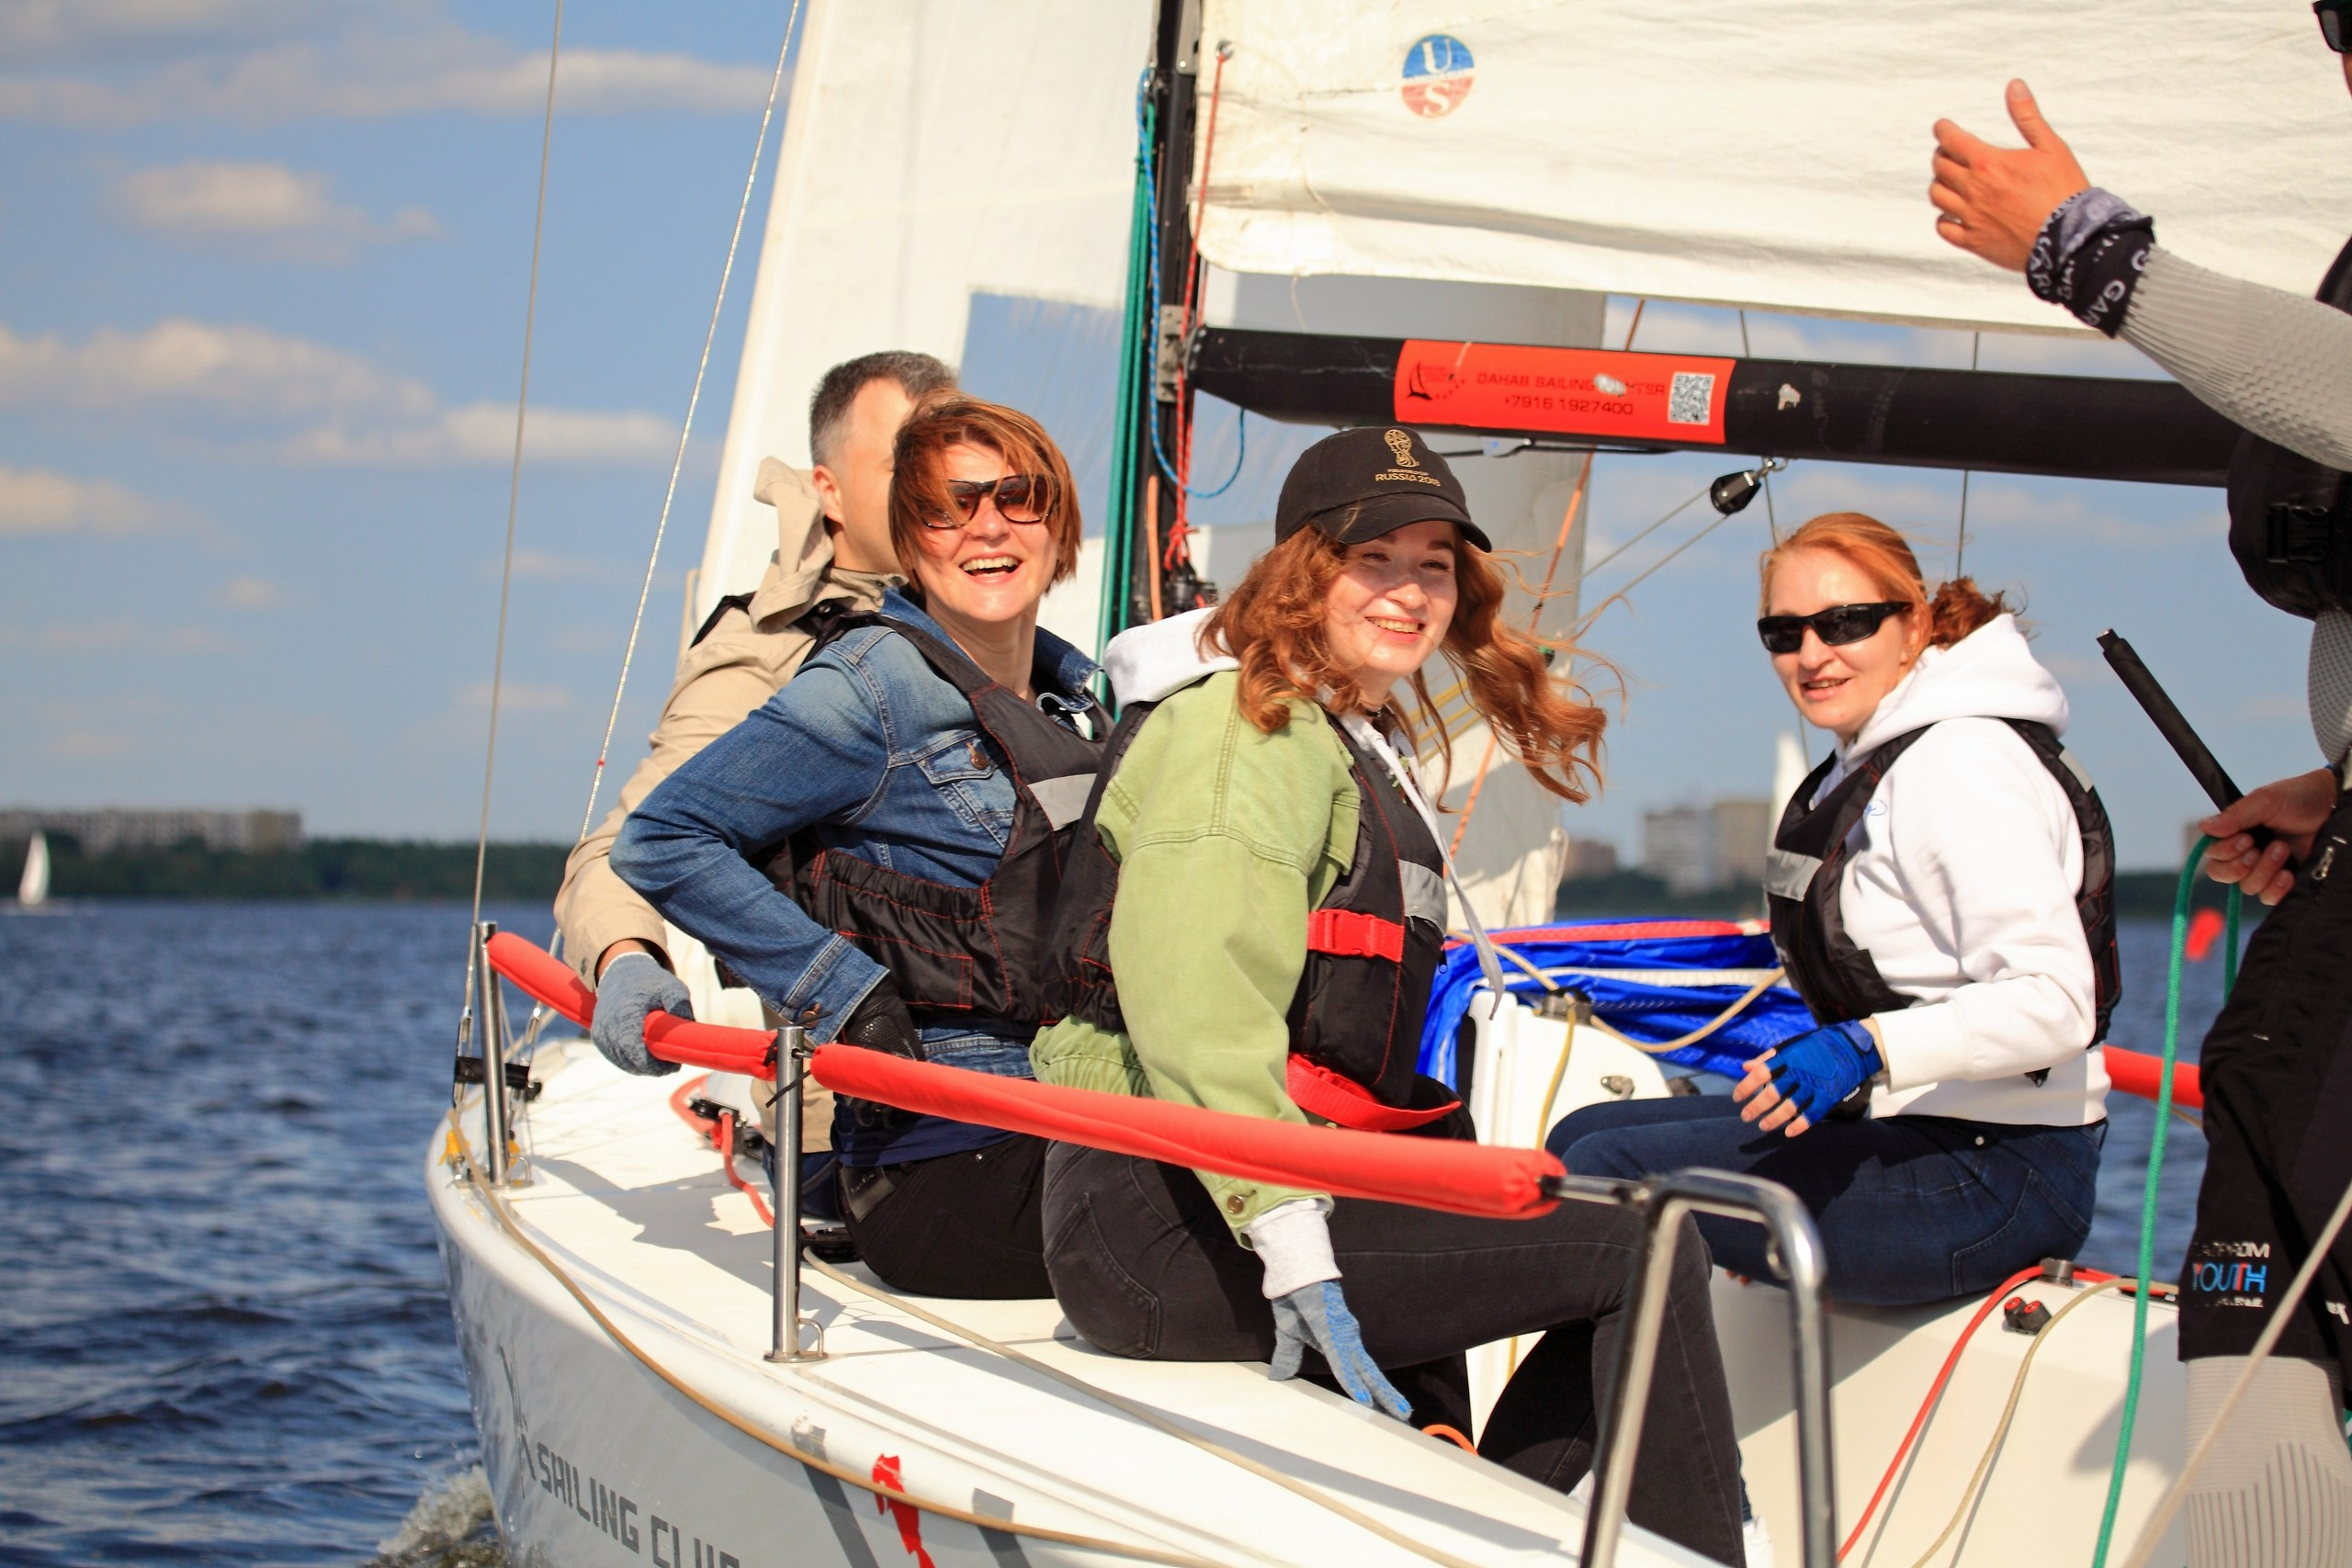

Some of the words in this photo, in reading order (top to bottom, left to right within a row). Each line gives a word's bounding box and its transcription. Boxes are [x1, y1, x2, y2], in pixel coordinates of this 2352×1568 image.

[1476, 372, 1530, 387] DAHAB
[1534, 375, 1595, 391] SAILING
[1558, 397, 1634, 415] 1927400
[1374, 472, 1418, 482] RUSSIA
[2192, 1261, 2267, 1293] YOUTH
[537, 1440, 640, 1555] SAILING
